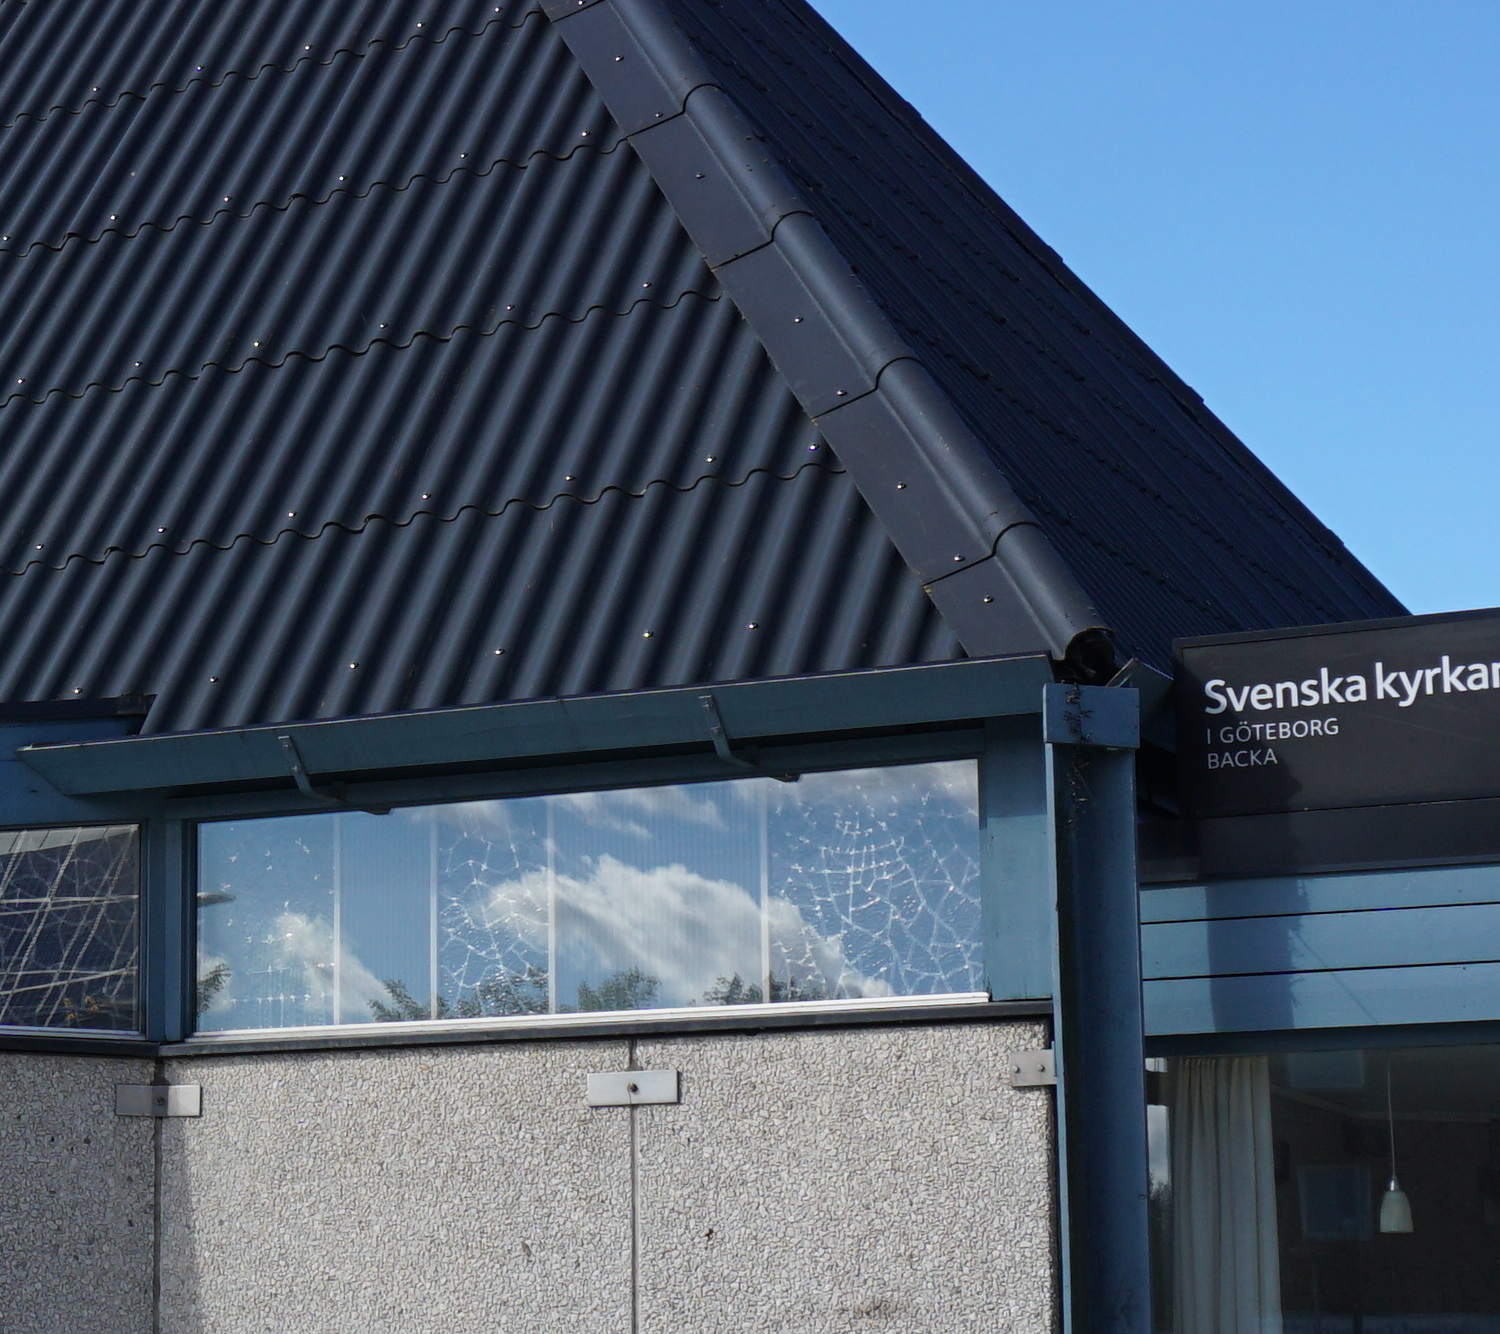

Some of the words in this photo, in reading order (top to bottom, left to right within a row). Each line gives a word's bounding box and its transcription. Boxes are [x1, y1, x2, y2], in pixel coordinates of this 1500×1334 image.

[1204, 667, 1367, 714] Svenska
[1206, 728, 1211, 744] I
[1219, 717, 1340, 744] GÖTEBORG
[1207, 748, 1278, 770] BACKA
